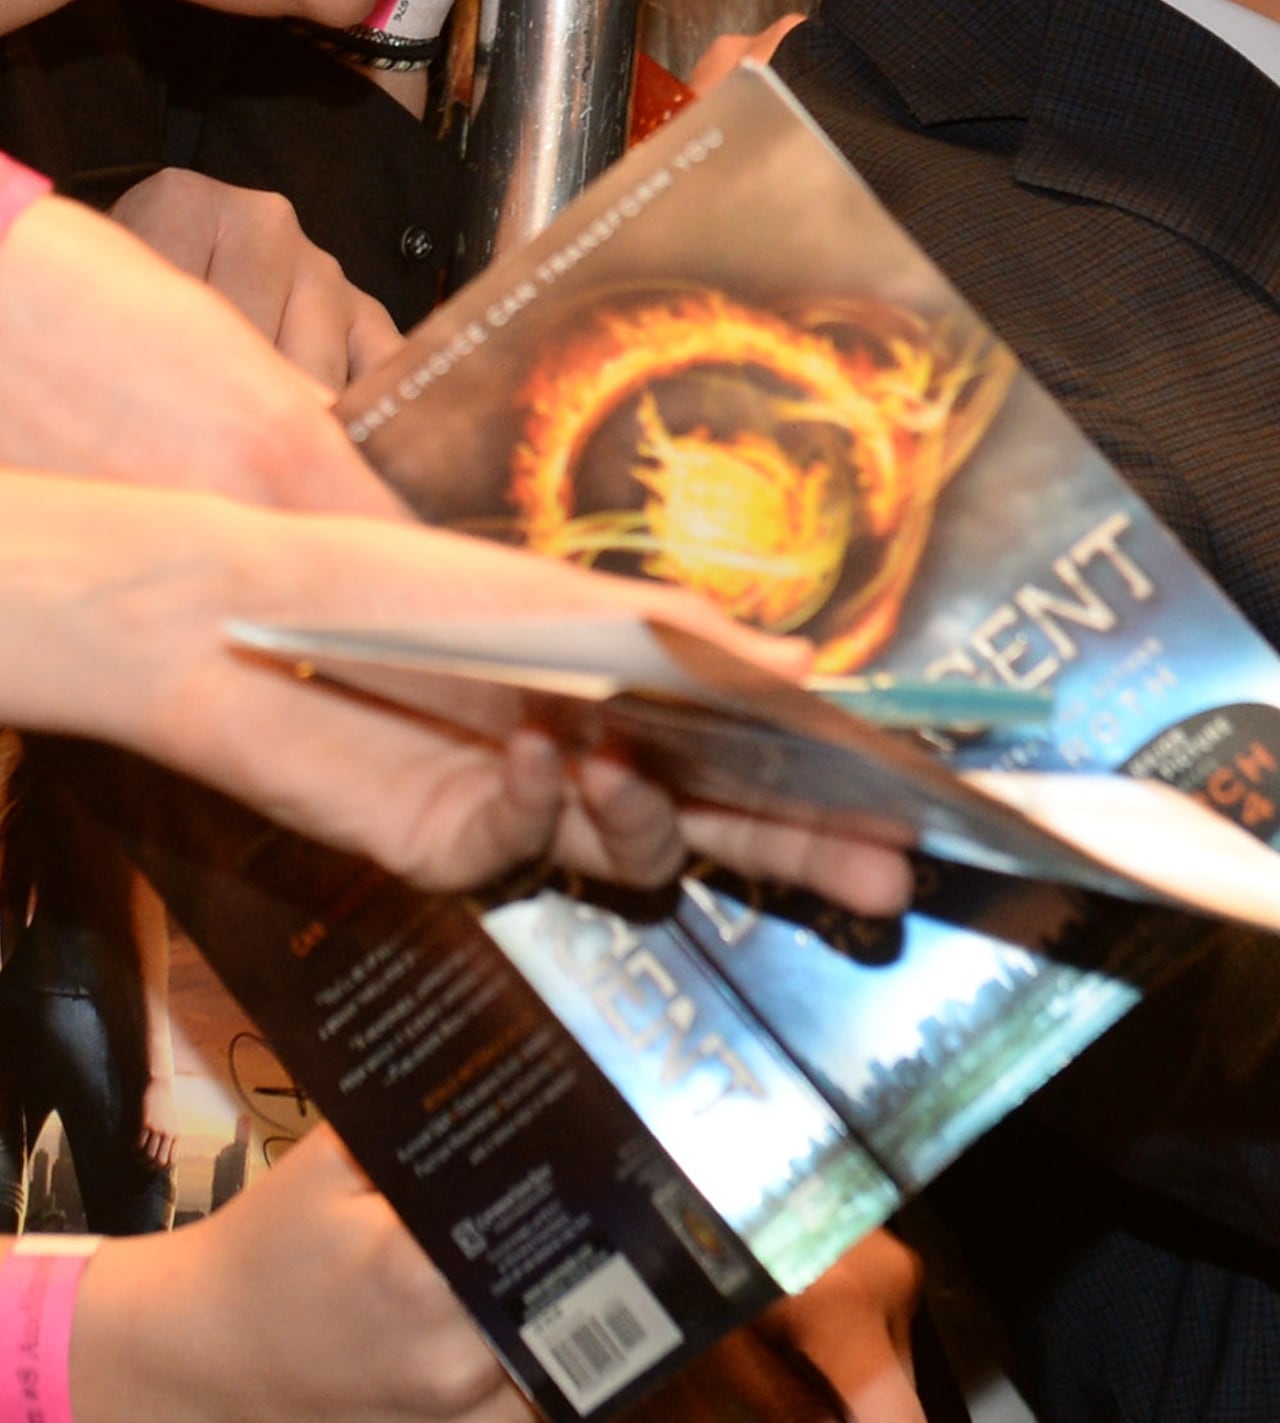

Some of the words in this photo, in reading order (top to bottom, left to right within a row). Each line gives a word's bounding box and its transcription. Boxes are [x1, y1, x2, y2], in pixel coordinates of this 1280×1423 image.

[349, 396, 401, 444] ONE
[400, 321, 489, 402] CHOICE
[487, 279, 538, 329] CAN
[537, 166, 675, 286] TRANSFORM
[674, 126, 726, 173] YOU
